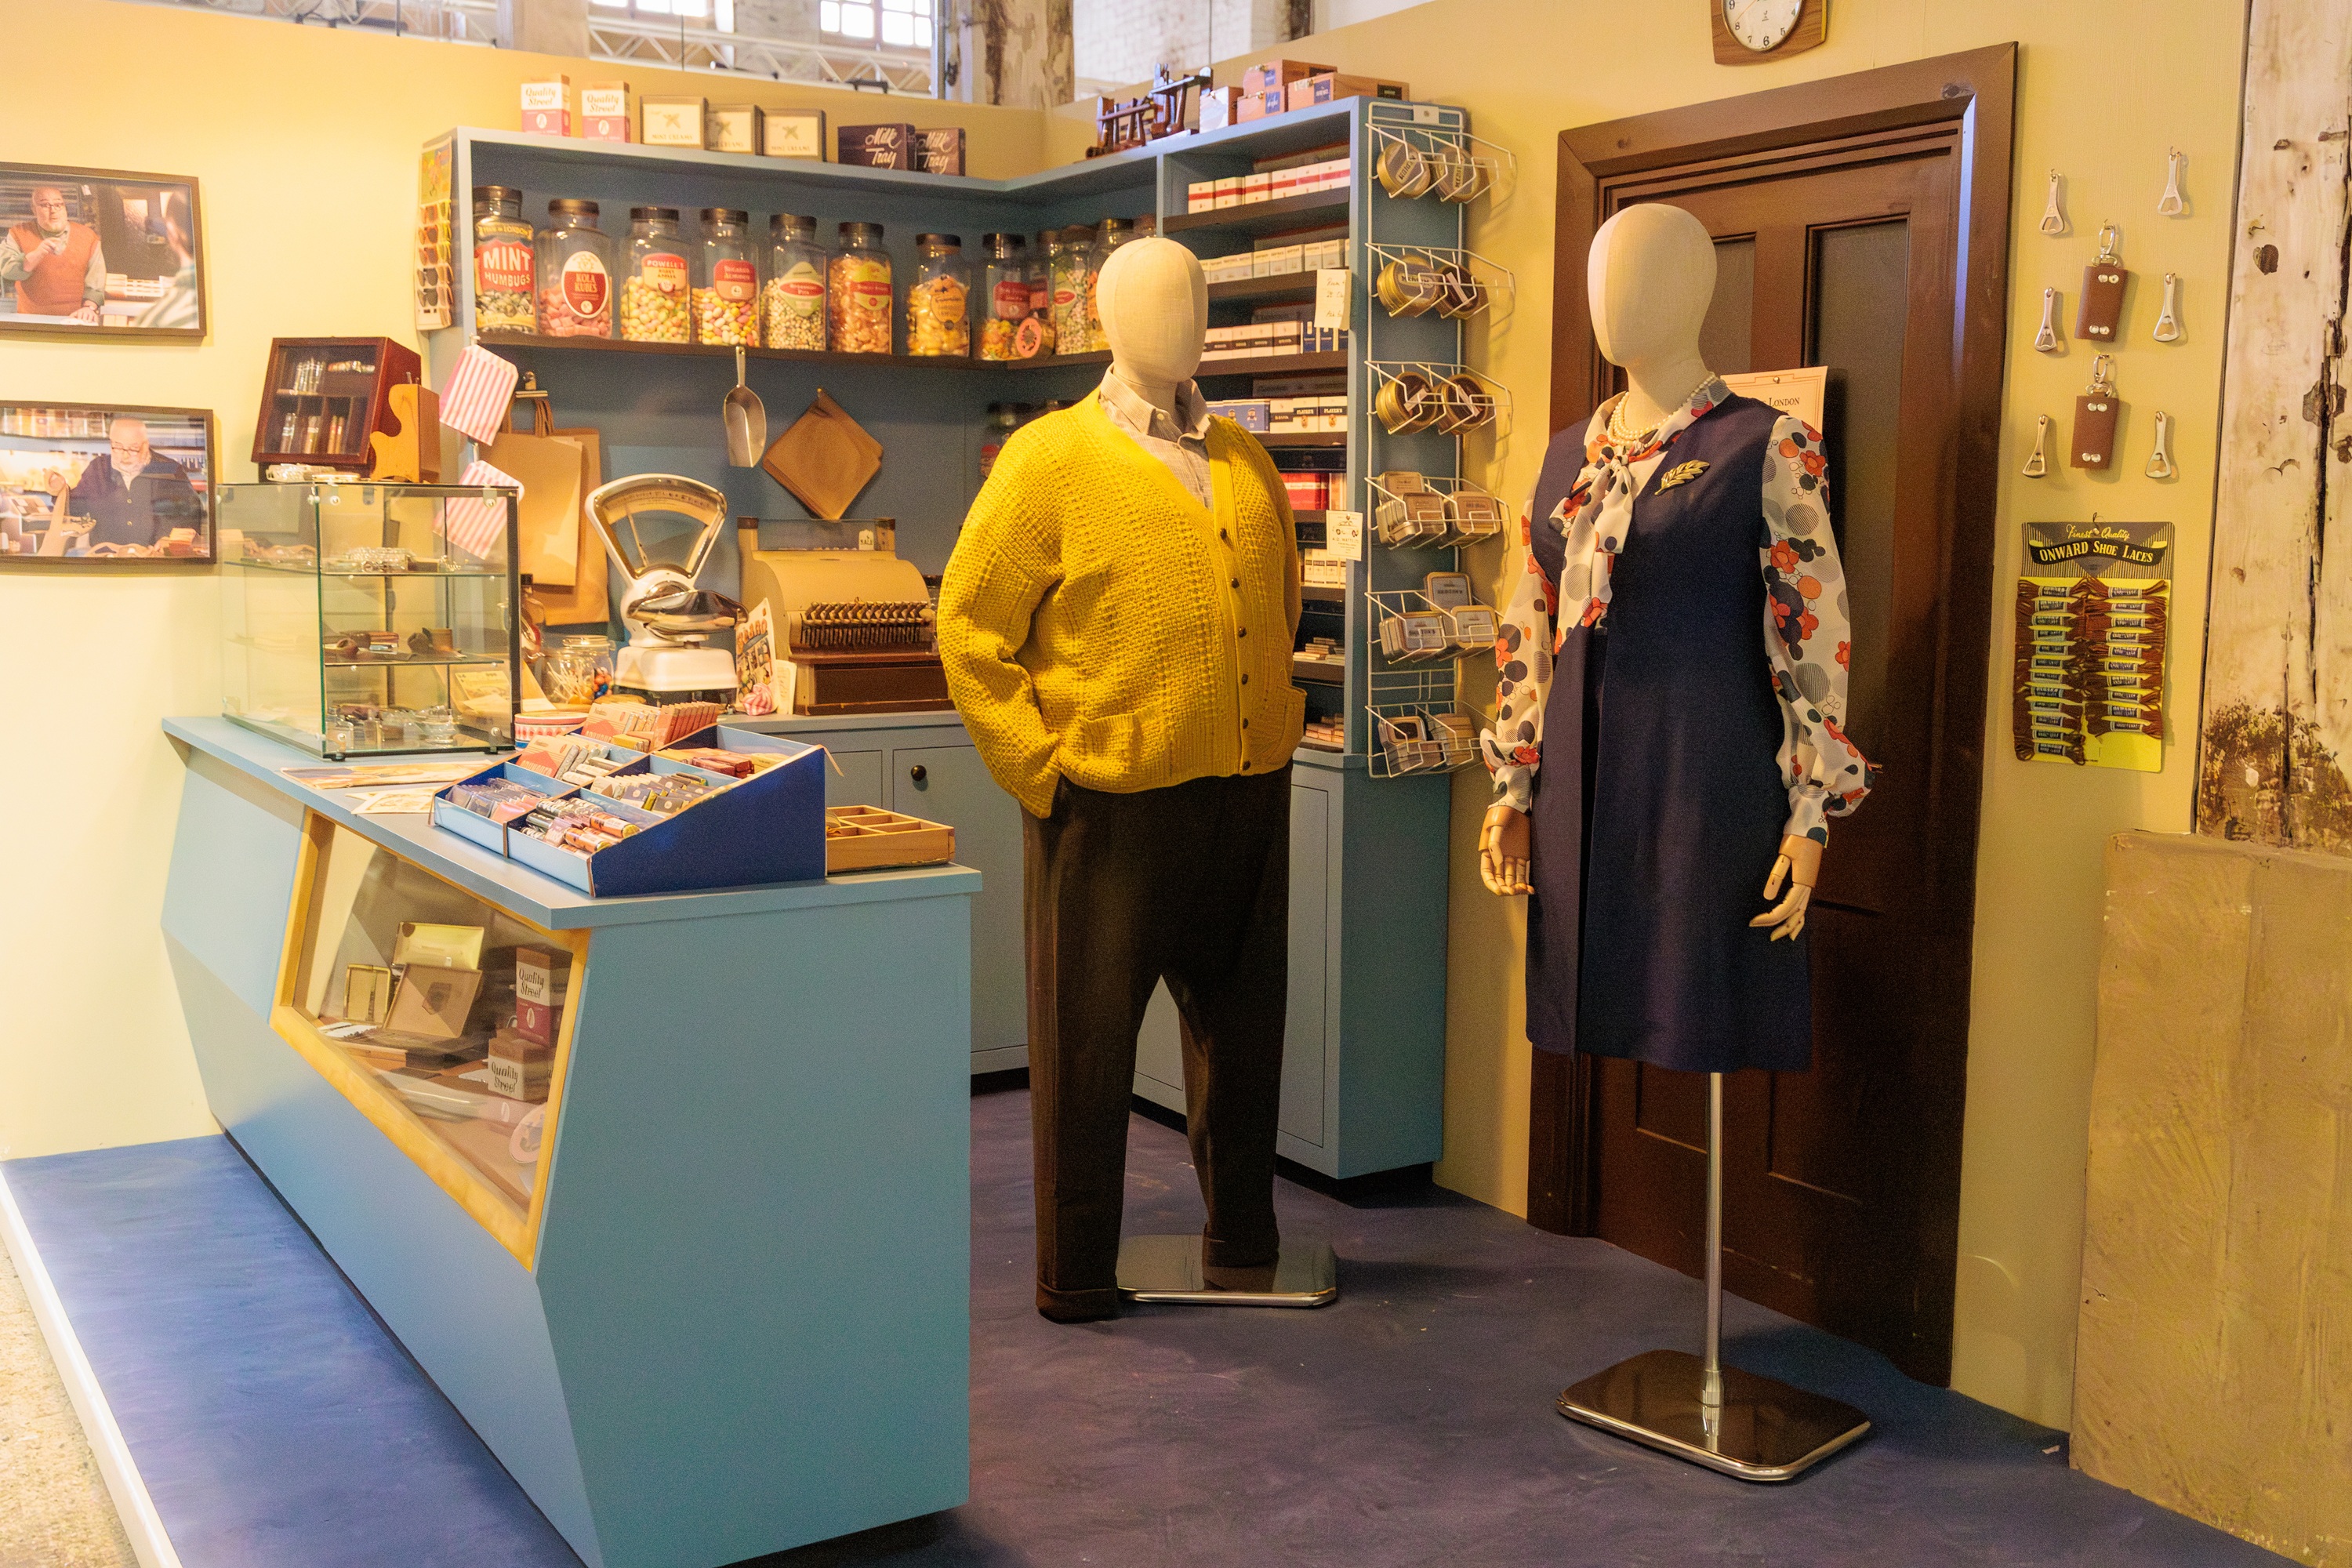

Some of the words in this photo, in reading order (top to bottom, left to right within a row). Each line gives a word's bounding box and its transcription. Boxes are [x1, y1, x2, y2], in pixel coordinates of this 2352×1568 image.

[1729, 0, 1735, 10] 9
[1763, 36, 1769, 46] 6
[525, 87, 556, 98] Quality
[528, 96, 553, 106] Street
[587, 94, 619, 105] Quality
[590, 103, 615, 113] Street
[865, 127, 902, 149] Milk
[917, 132, 954, 153] Milk
[866, 147, 897, 169] Tray
[918, 151, 949, 174] Tray
[483, 246, 531, 271] MINT
[485, 272, 531, 287] HUMBUGS
[575, 274, 595, 284] KOLA
[575, 282, 597, 293] KUBES
[2066, 524, 2092, 539] Finest
[2101, 527, 2130, 541] Quality
[2039, 541, 2089, 561] ONWARD
[2092, 540, 2118, 556] SHOE
[2122, 545, 2154, 563] LACES
[519, 968, 544, 990] Quality
[521, 981, 542, 999] Street
[492, 1062, 518, 1085] Quality
